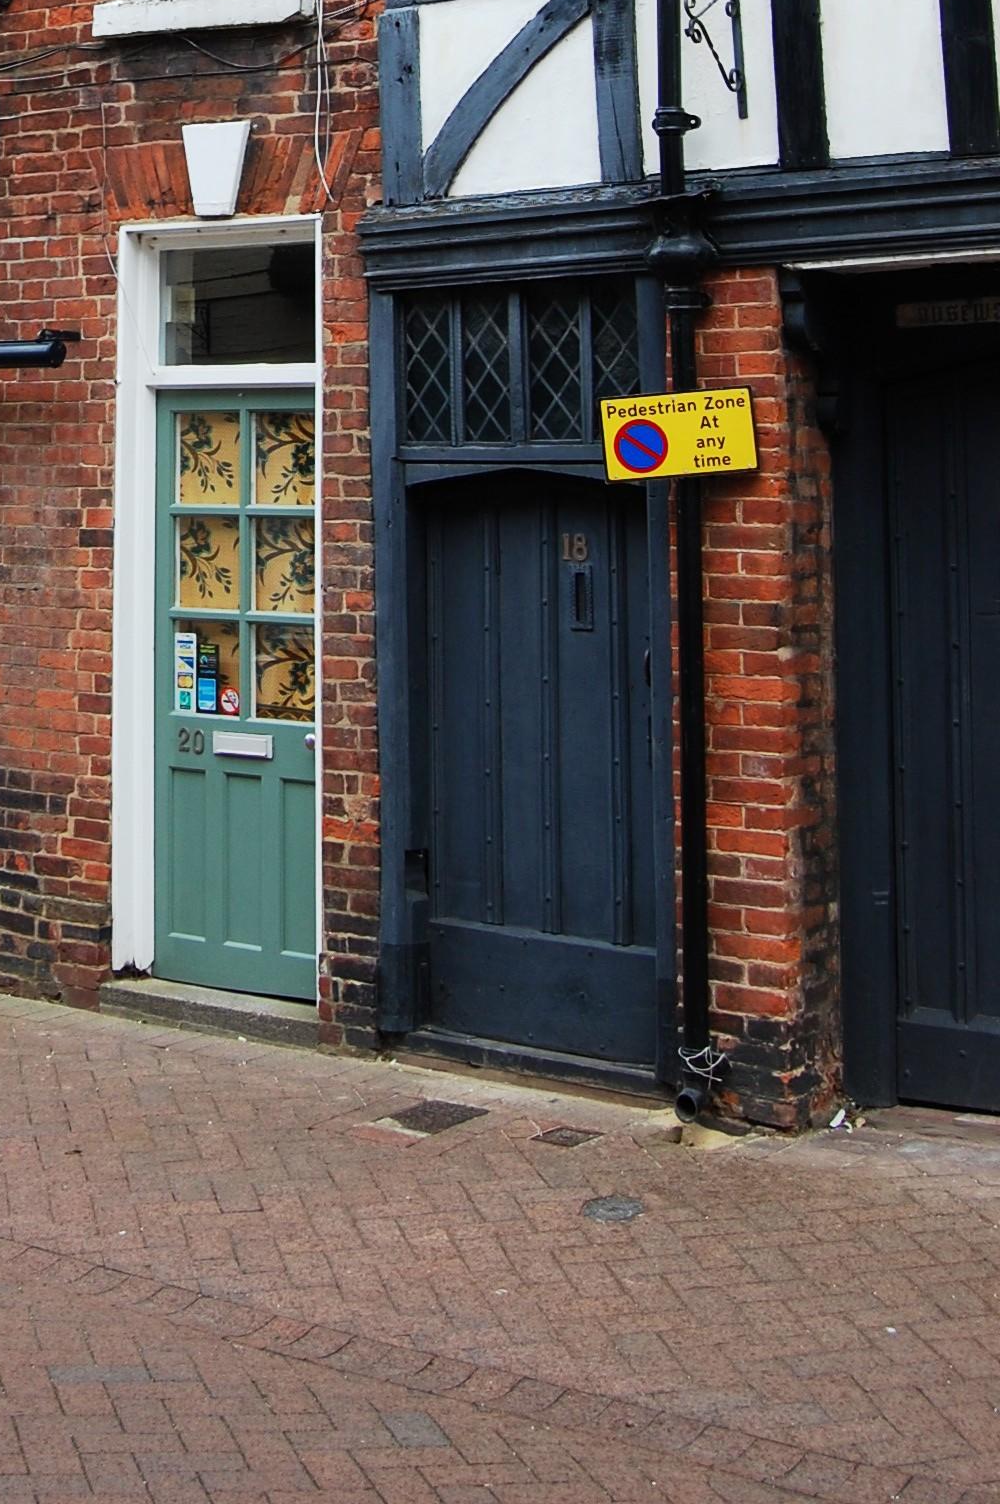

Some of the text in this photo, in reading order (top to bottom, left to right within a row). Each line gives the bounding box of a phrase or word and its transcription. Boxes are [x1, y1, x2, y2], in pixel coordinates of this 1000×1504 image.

[606, 395, 746, 420] Pedestrian Zone
[700, 415, 720, 430] At
[696, 436, 726, 450] any
[693, 454, 732, 469] time
[562, 533, 588, 562] 18
[177, 727, 206, 756] 20
